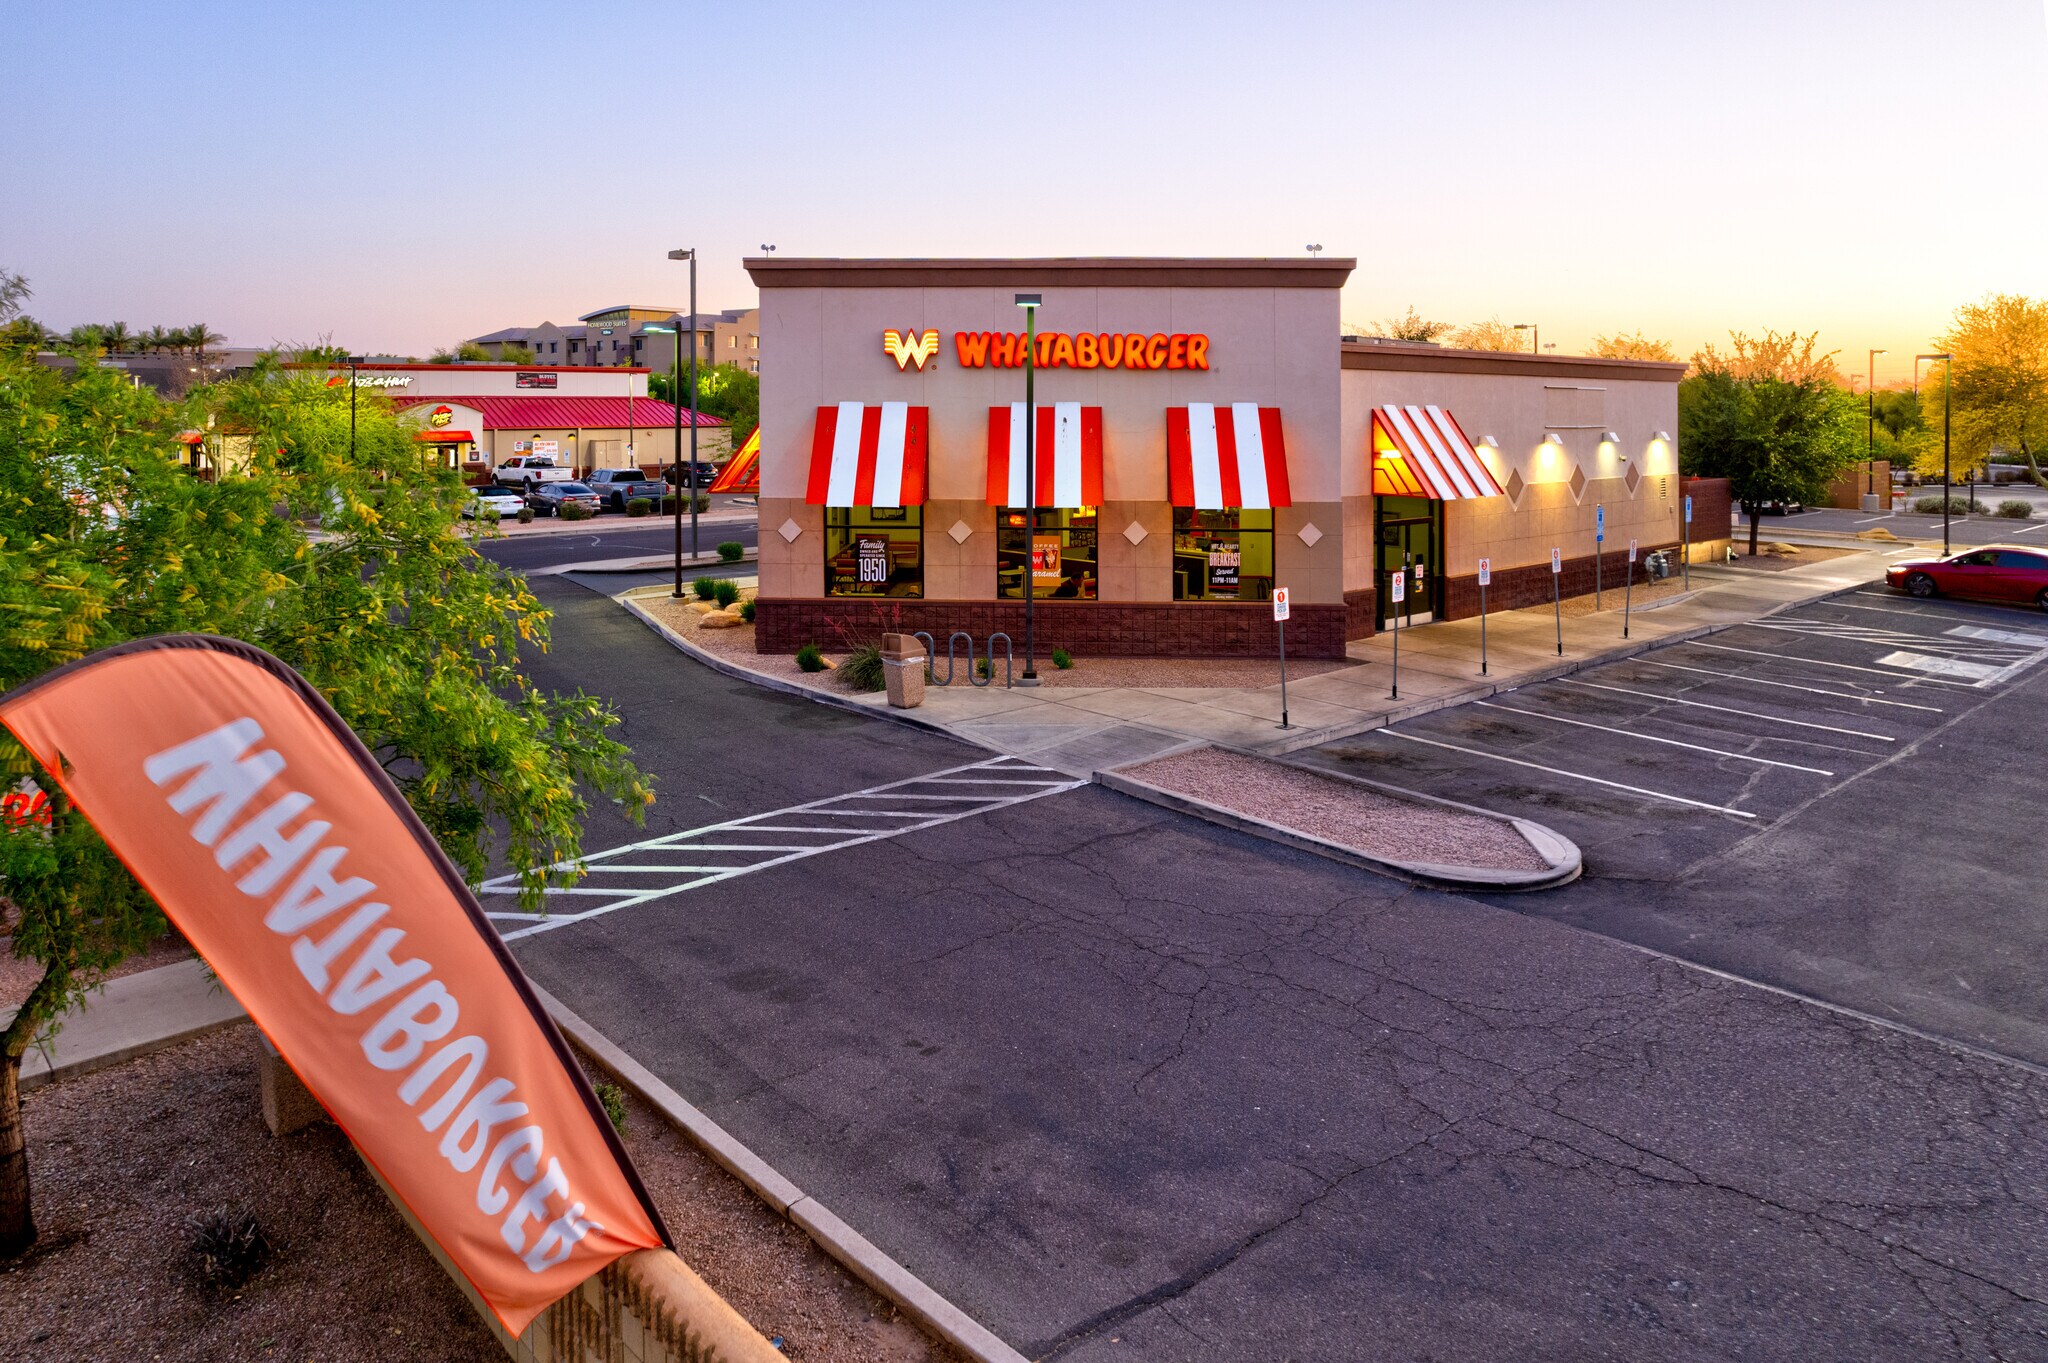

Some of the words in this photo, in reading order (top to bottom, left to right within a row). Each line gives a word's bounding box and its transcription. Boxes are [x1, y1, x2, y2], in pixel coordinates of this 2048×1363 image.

[954, 331, 1210, 371] WHATABURGER
[859, 539, 886, 553] Family
[1209, 552, 1241, 567] BREAKFAST
[858, 558, 887, 582] 1950
[1032, 568, 1061, 578] aramel
[1216, 568, 1234, 576] Served
